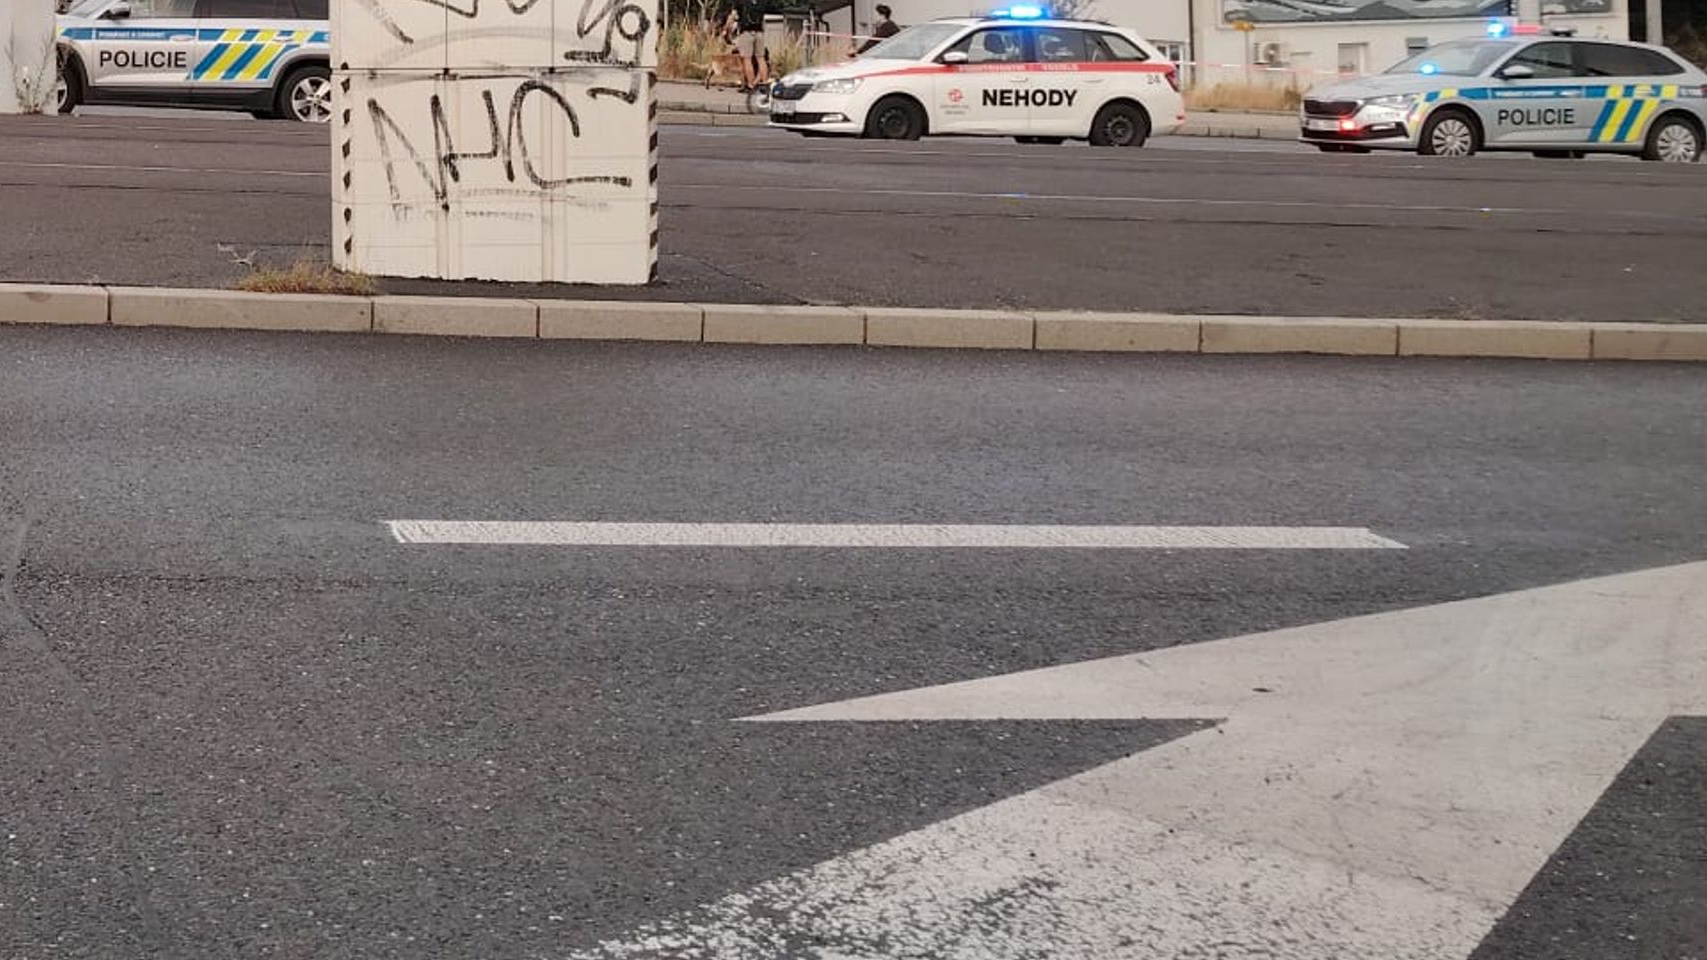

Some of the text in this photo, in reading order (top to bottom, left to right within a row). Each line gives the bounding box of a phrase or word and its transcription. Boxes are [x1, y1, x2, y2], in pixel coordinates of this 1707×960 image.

[99, 50, 187, 68] POLICIE
[982, 89, 1077, 107] NEHODY
[1498, 108, 1575, 126] POLICIE
